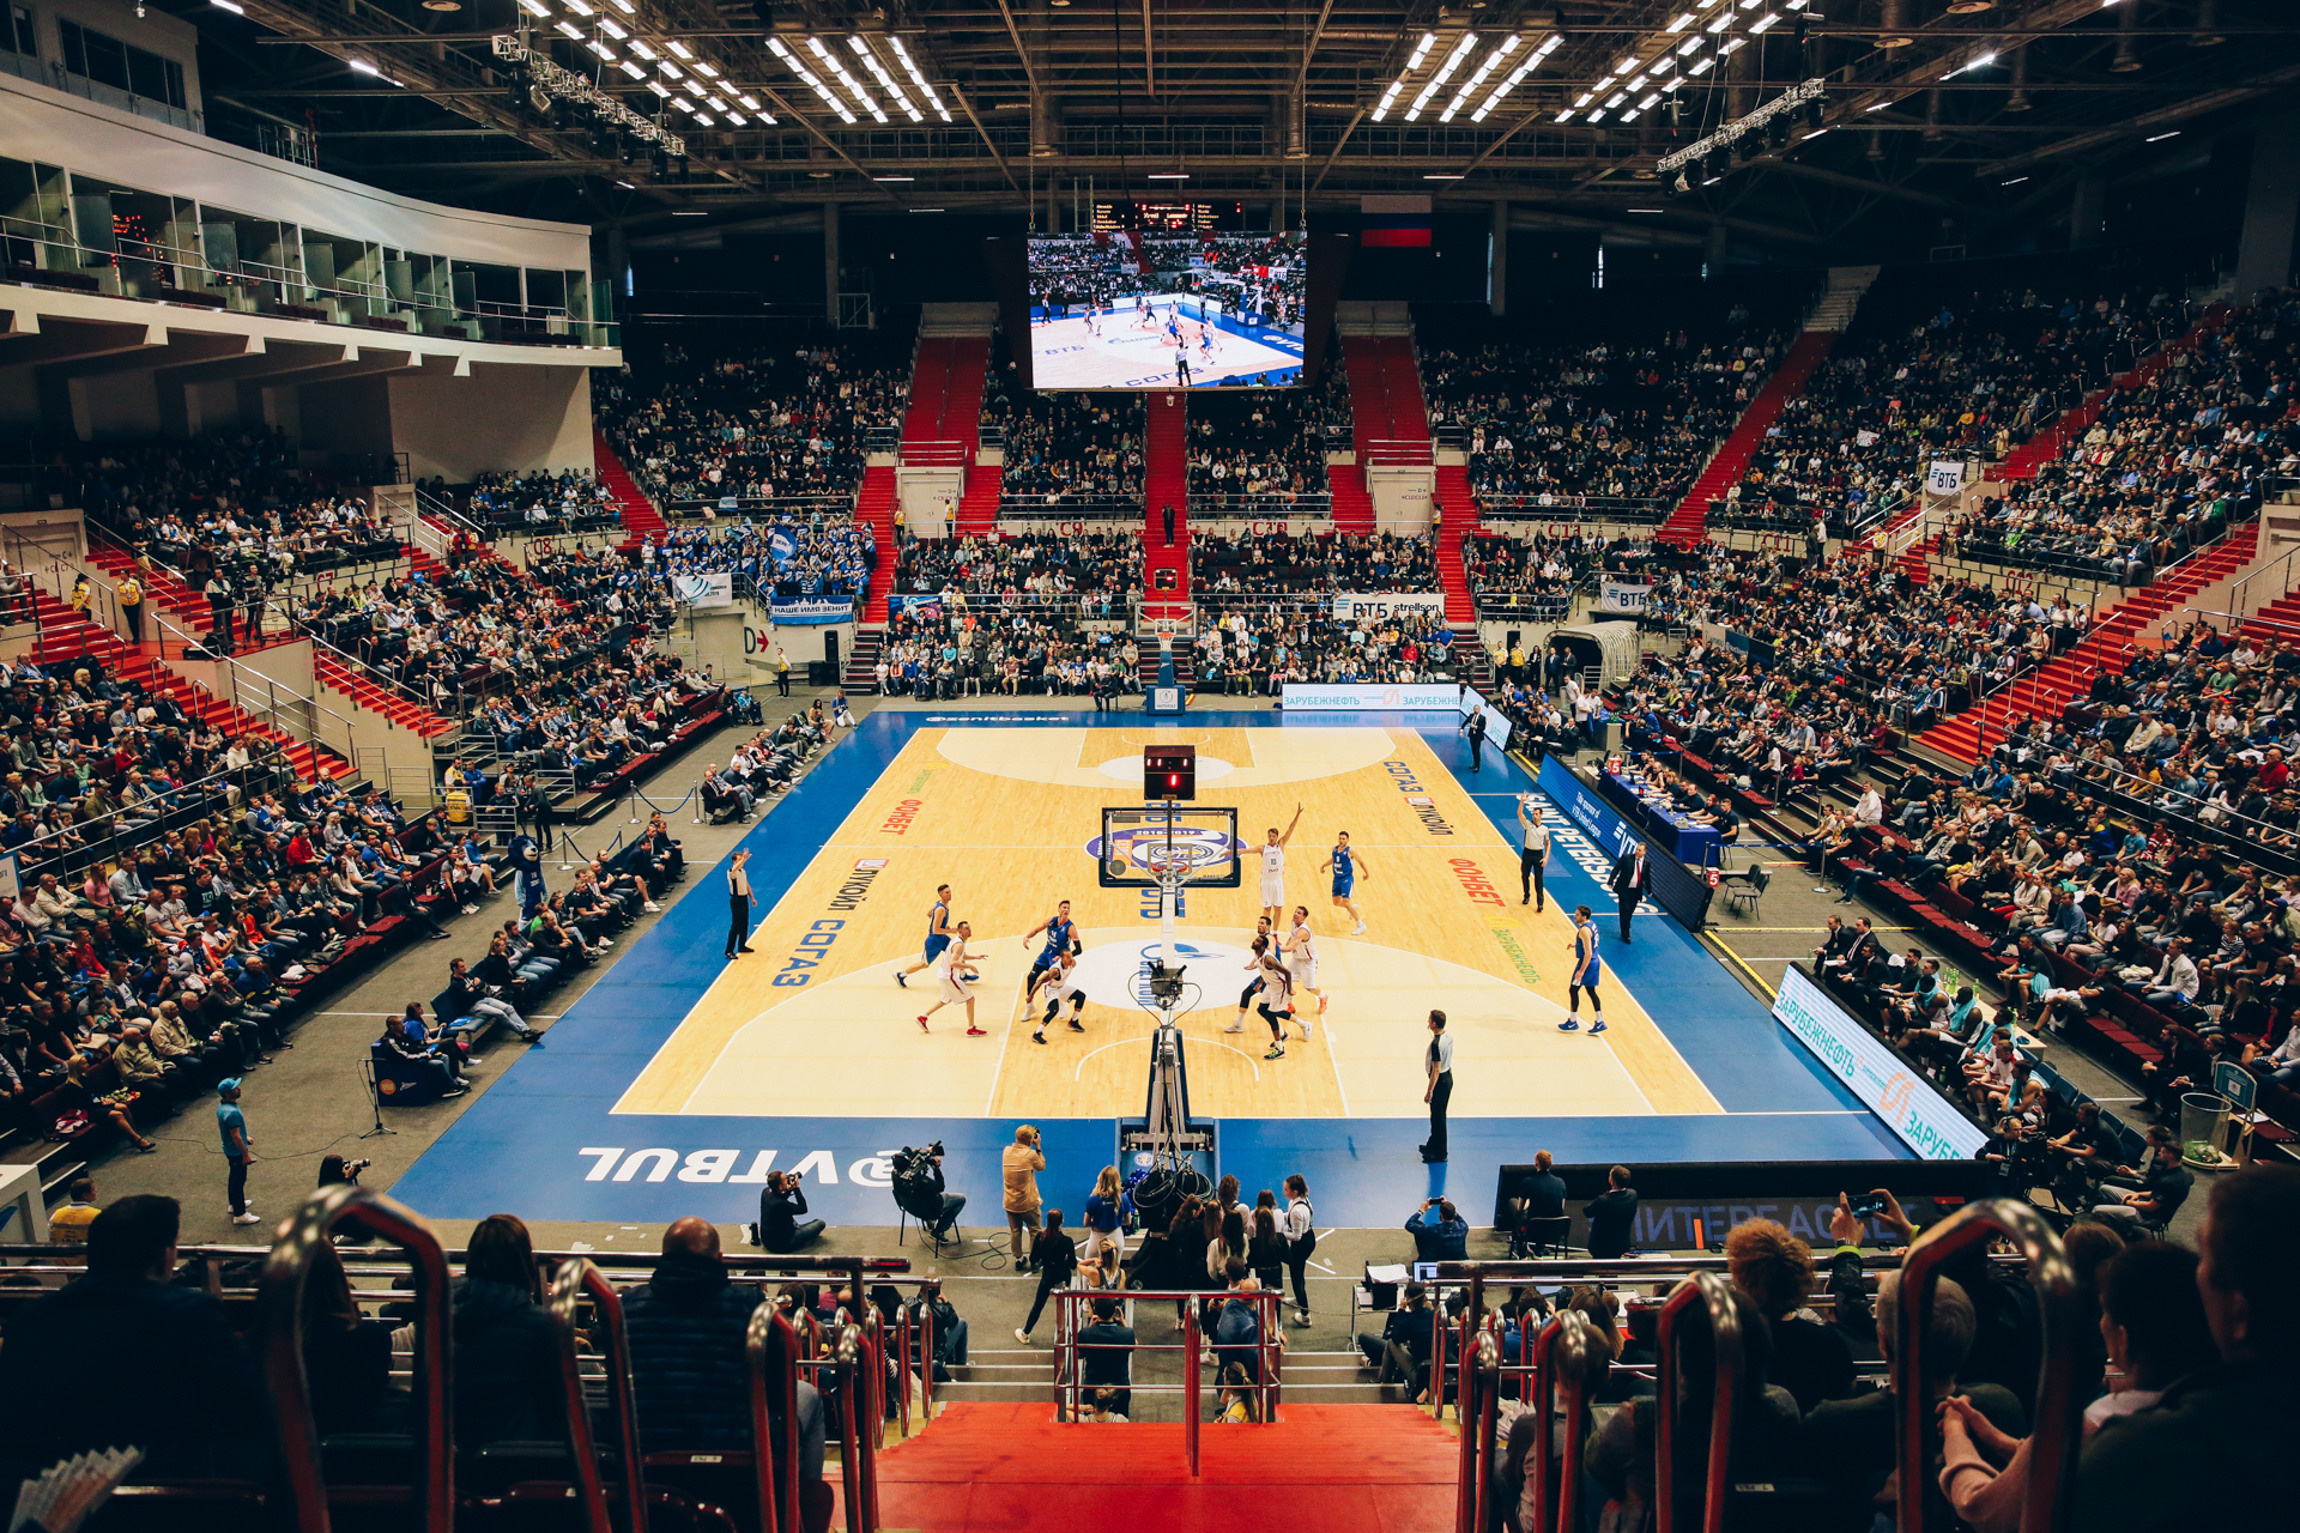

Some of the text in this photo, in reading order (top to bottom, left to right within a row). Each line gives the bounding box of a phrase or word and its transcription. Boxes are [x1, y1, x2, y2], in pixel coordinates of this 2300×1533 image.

[1125, 367, 1204, 387] СОГЗ
[1937, 472, 1957, 489] ВТБ
[774, 606, 800, 614] НАШЕ
[822, 605, 850, 613] ЗЕНИТ
[1394, 602, 1439, 612] strellson
[744, 626, 756, 654] D
[1284, 696, 1360, 706] ЗАРУБЕЖНЕФТЬ
[1383, 761, 1424, 792] СОГАЗ
[1611, 762, 1620, 773] 5
[880, 799, 923, 835] ФОНБЕТ
[1411, 804, 1454, 835] ЛУКОЙЛ
[827, 868, 879, 911] ЛУКОЙЛ
[1448, 858, 1506, 907] ФОНБЕТ
[1709, 873, 1719, 885] 5
[771, 919, 846, 987] СОГАЗ
[1775, 990, 1856, 1078] ЗАРУБЕЖНЕФТЬ
